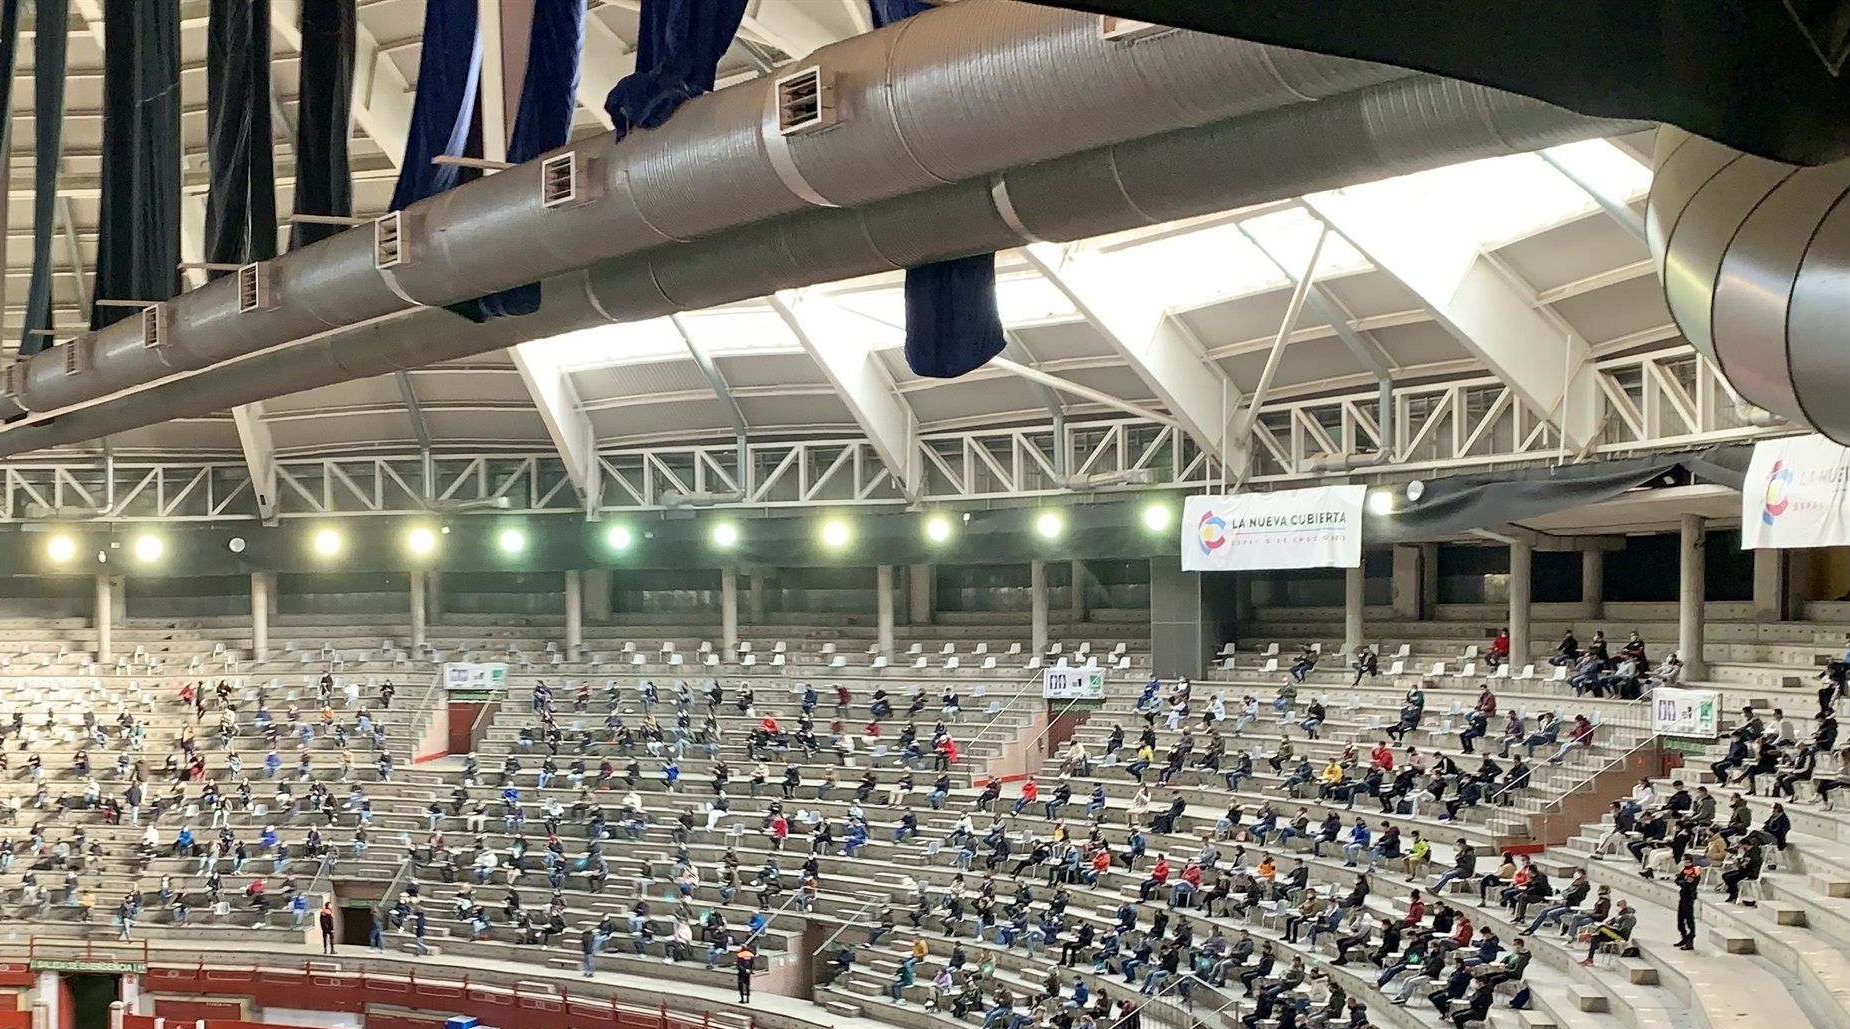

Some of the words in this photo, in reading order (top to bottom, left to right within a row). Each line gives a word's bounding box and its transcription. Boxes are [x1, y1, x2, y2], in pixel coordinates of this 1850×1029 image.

[1232, 517, 1246, 529] LA
[1249, 515, 1288, 528] NUEVA
[1290, 511, 1347, 526] CUBIERTA
